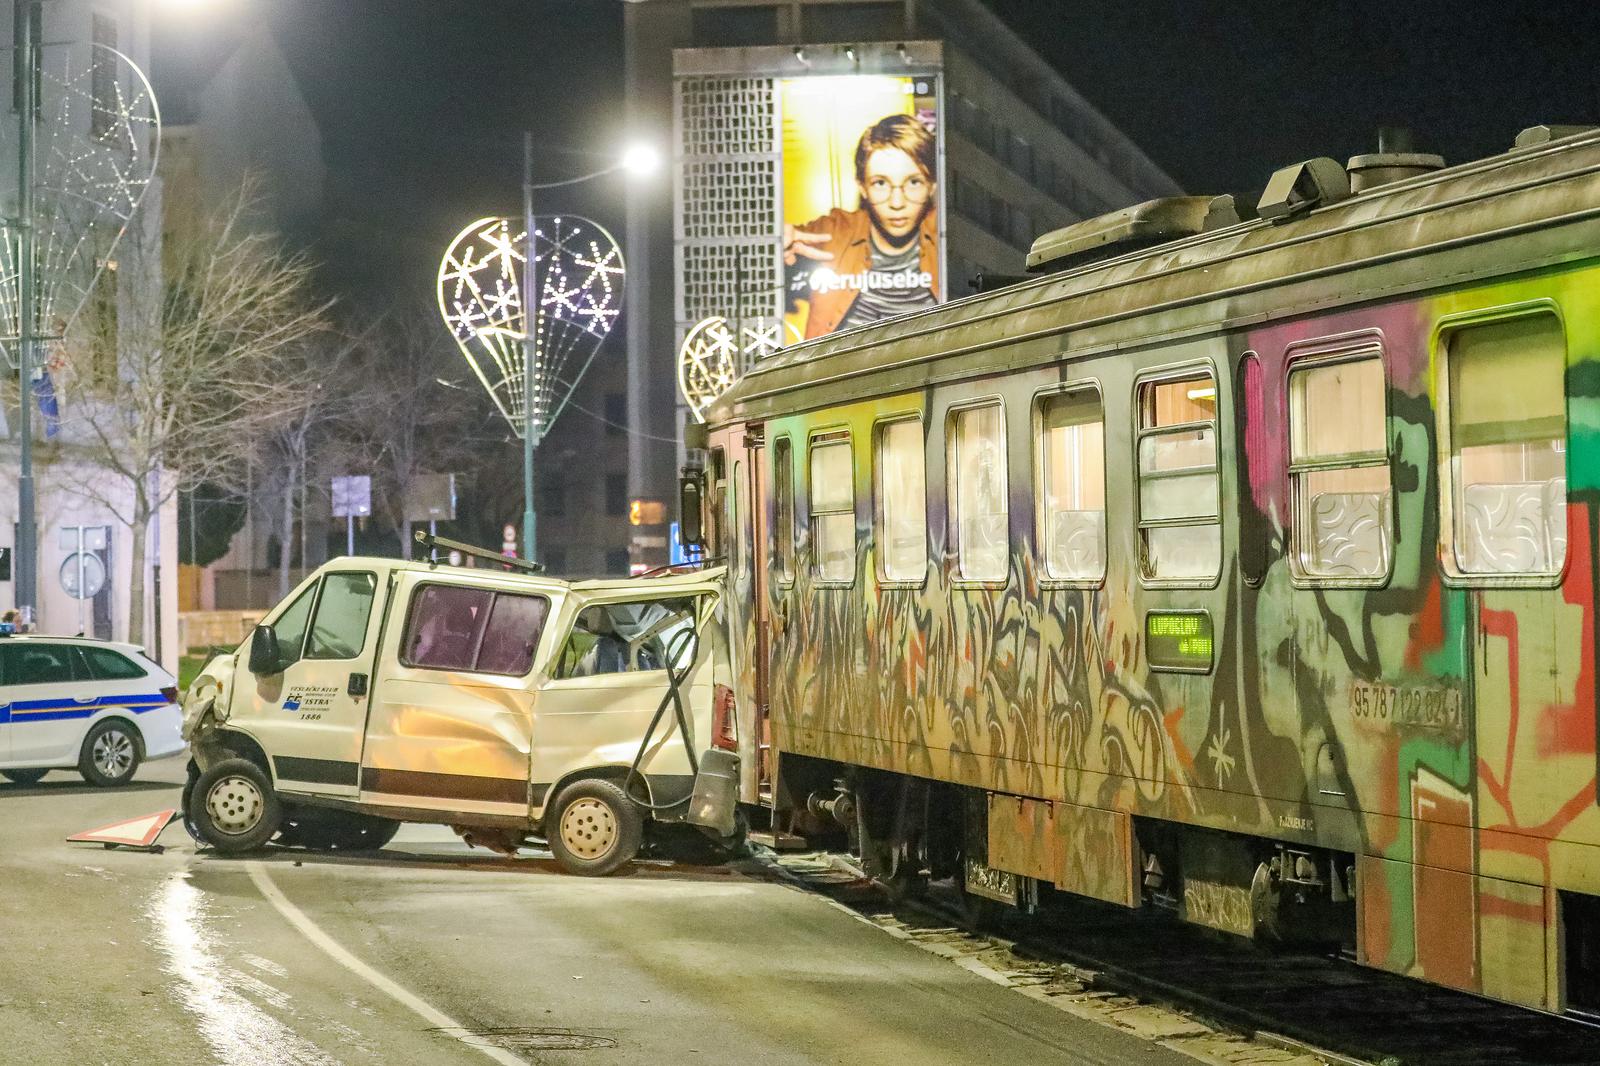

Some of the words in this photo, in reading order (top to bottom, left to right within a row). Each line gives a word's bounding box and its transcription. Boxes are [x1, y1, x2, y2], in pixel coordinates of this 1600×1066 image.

[1354, 686, 1370, 718] 95
[1372, 687, 1387, 719] 78
[1390, 688, 1397, 719] 7
